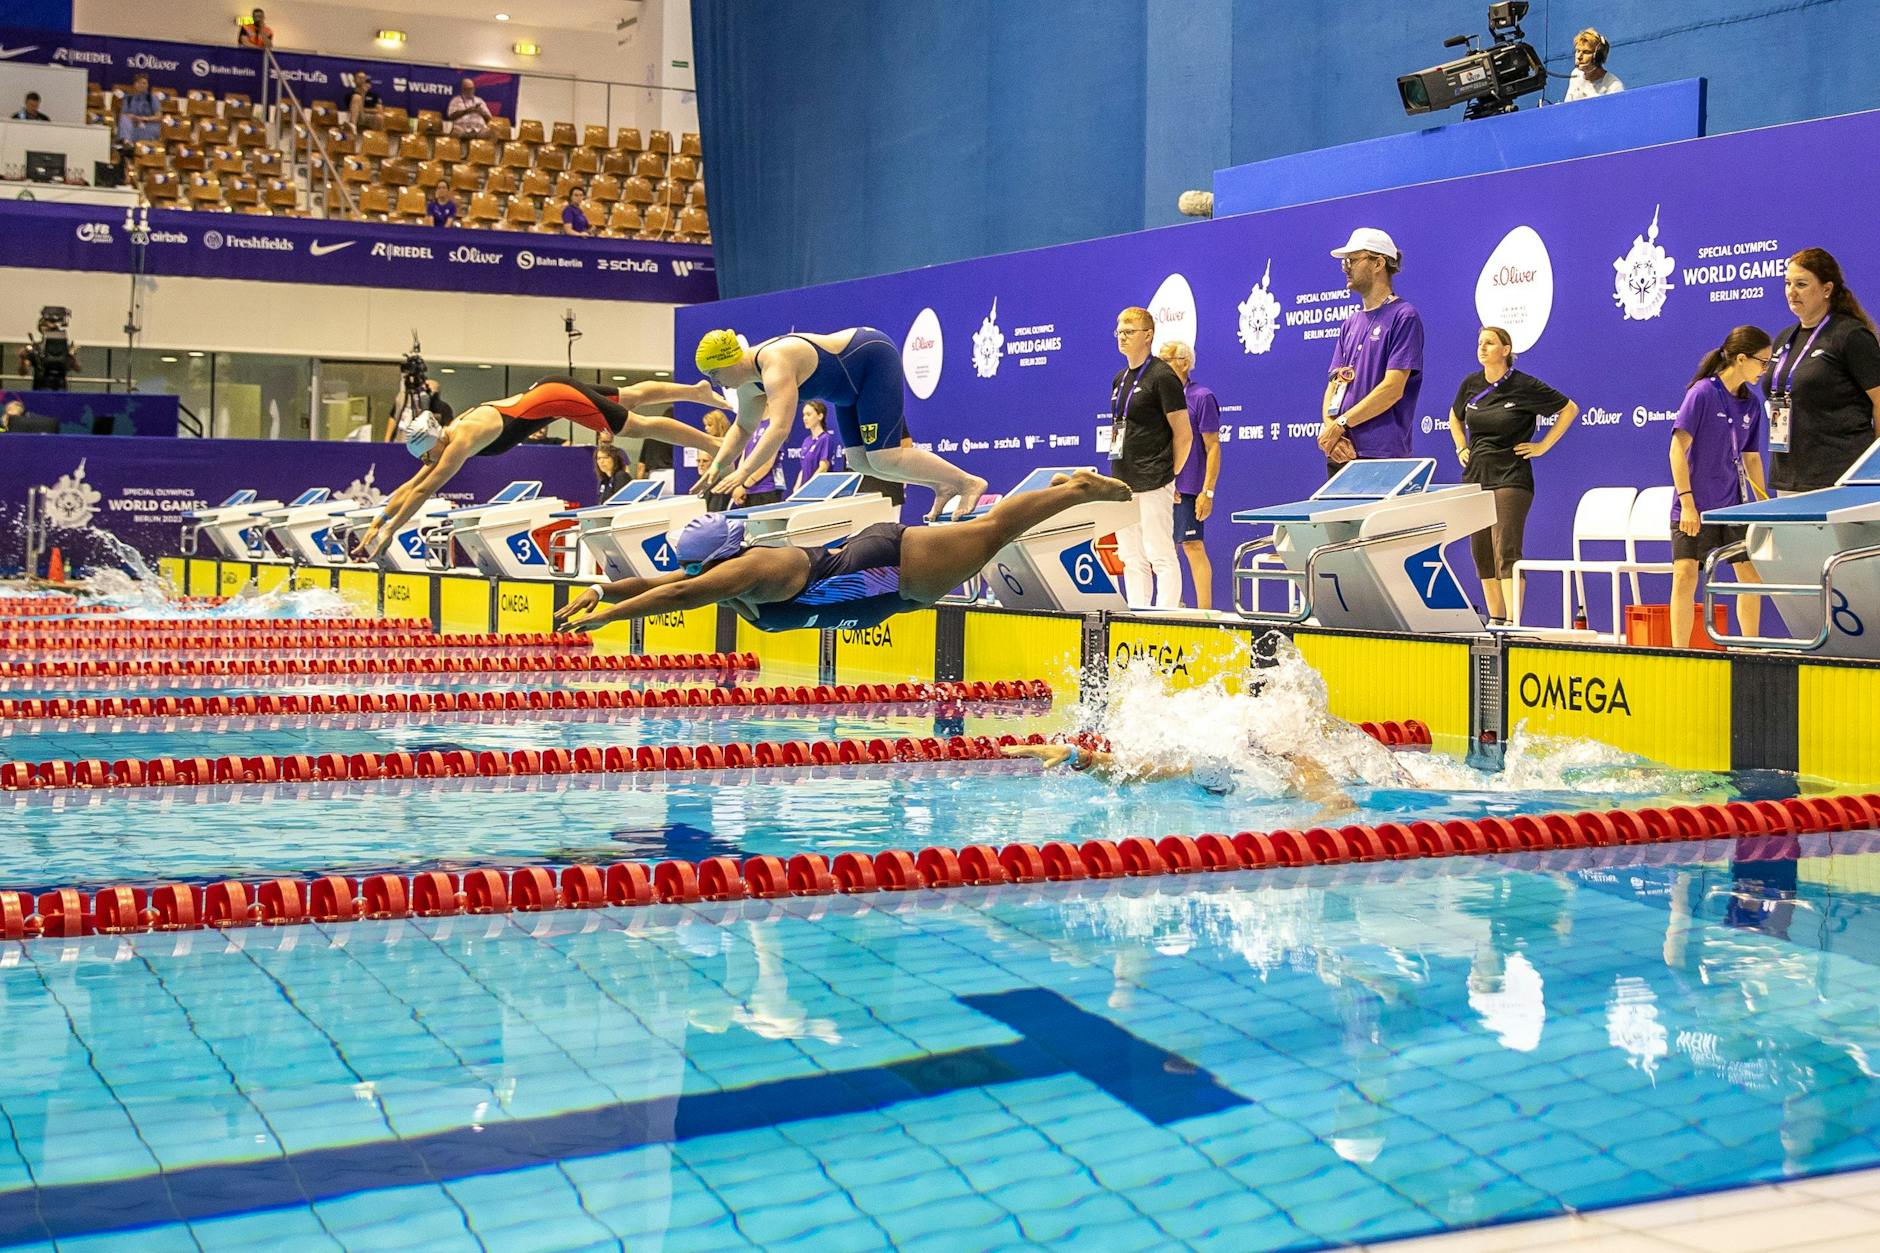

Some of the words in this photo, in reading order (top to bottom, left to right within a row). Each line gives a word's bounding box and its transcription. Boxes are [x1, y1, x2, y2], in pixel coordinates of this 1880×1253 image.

[150, 231, 188, 243] airbnb
[226, 235, 294, 250] Freshfields
[393, 246, 434, 259] RIEDEL
[449, 246, 503, 264] s.Oliver
[1698, 245, 1733, 259] SPECIAL
[1733, 240, 1778, 255] OLYMPICS
[536, 257, 557, 266] Bahn
[558, 258, 583, 268] Berlin
[610, 259, 658, 273] schufa
[1492, 265, 1537, 287] s.Oliver
[1683, 263, 1736, 286] WORLD
[1296, 292, 1320, 305] SPECIAL
[1320, 288, 1351, 302] OLYMPICS
[1709, 289, 1739, 303] BERLIN
[1740, 287, 1764, 300] 2023
[1285, 308, 1322, 326] WORLD
[1303, 329, 1324, 340] BERLIN
[1324, 327, 1341, 339] 2023
[1006, 340, 1034, 355] WORLD
[1034, 336, 1062, 352] GAMES
[1581, 407, 1622, 425] s.Oliver
[1648, 411, 1665, 421] Bahn
[1238, 425, 1264, 440] REWE
[108, 499, 159, 511] WORLD
[160, 499, 208, 511] GAMES
[408, 536, 422, 556] 2
[516, 538, 532, 562] 3
[653, 542, 671, 567] 4
[1075, 553, 1094, 586] 6
[997, 562, 1024, 596] 6
[1422, 561, 1444, 599] 7
[386, 584, 411, 601] OMEGA
[1319, 573, 1349, 612] 7
[501, 593, 529, 614] OMEGA
[842, 623, 893, 648] OMEGA
[1519, 671, 1632, 717] OMEGA
